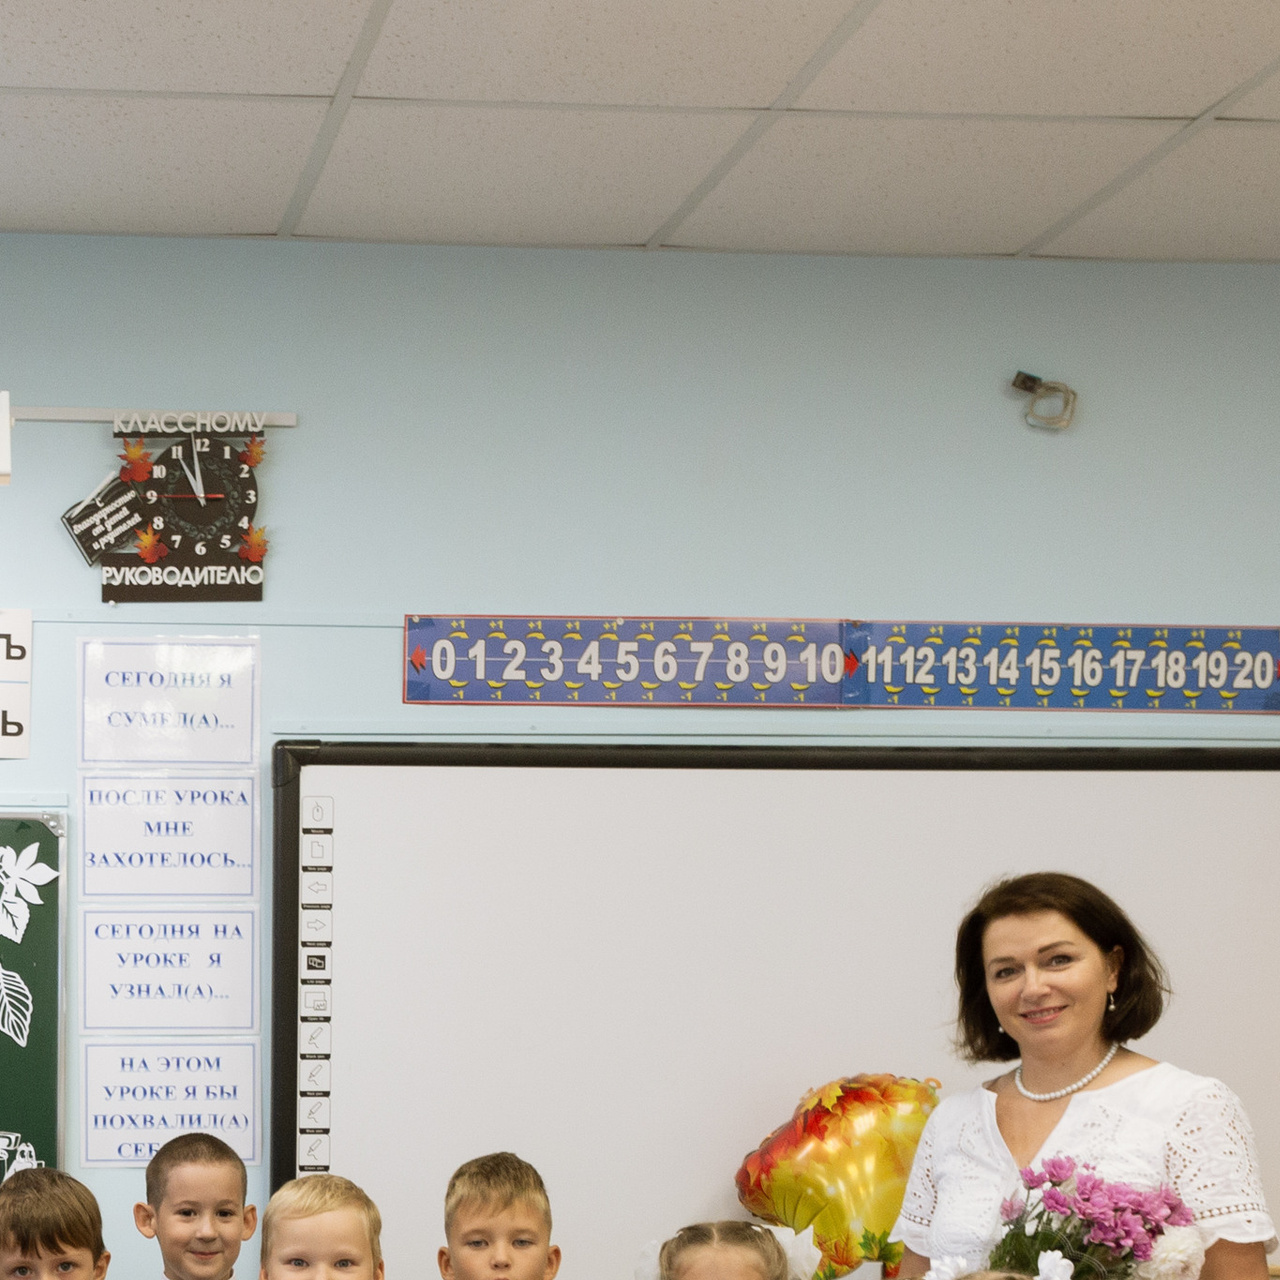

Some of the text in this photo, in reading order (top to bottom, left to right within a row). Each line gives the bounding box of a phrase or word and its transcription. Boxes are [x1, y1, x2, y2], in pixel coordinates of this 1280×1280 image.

[113, 412, 267, 433] КЛАССНОМУ
[195, 438, 210, 452] 12
[223, 446, 231, 460] 1
[152, 465, 167, 478] 10
[239, 464, 250, 478] 2
[146, 490, 157, 504] 9
[245, 490, 257, 504] 3
[152, 516, 164, 530] 8
[238, 516, 250, 529] 4
[171, 535, 182, 548] 7
[195, 542, 206, 555] 6
[220, 535, 231, 549] 5
[102, 565, 264, 587] РУКОВОДИТЕЛЮ
[450, 619, 806, 633] +1 +1 +1 +1 +1 +1 +1 +1 +1 +1
[891, 624, 1242, 640] +1 +1 +1 +1 +1 +1 +1 +1 +1 +1
[432, 639, 845, 684] 0 1 2 3 4 5 6 7 8 9 10
[862, 645, 1274, 689] 11 12 13 14 15 16 17 18 19 20
[105, 671, 233, 690] СЕГОДНЯ Я
[452, 690, 805, 702] -1 -1 -1 -1 -1 -1 -1 -1 -1 -1
[1, 710, 24, 737] ь
[89, 790, 249, 806] ПОСЛЕ УРОКА
[144, 821, 194, 837] МНЕ
[85, 852, 252, 868] ЗАХОТЕЛОСЬ...
[94, 924, 243, 942] СЕГОДНЯ НА
[117, 953, 222, 968] УРОКЕ Я
[109, 983, 230, 1003] УЗНАЛ(А)...
[120, 1057, 223, 1072] НА ЭТОМ
[103, 1085, 238, 1101] УРОКЕ Я БЫ
[93, 1114, 249, 1132] ПОХВАЛИЛ(А)
